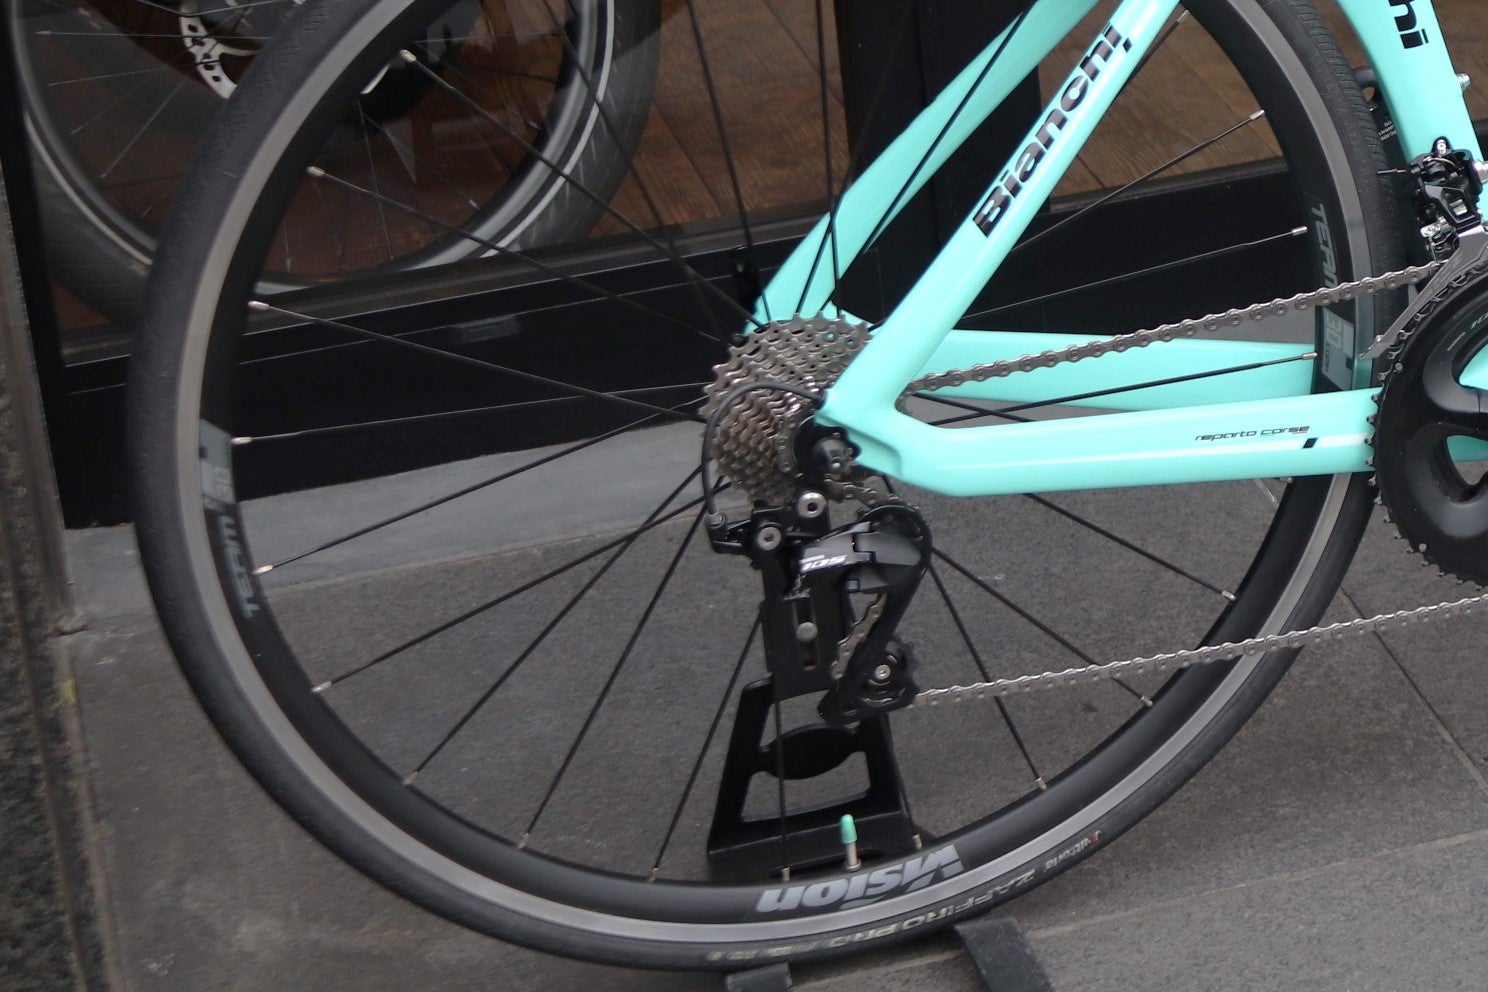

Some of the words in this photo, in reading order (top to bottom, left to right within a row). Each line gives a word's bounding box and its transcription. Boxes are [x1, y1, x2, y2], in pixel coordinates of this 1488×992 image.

[972, 21, 1122, 238] Bianchi
[1326, 314, 1342, 349] 30
[1195, 430, 1257, 442] reparto
[1260, 425, 1310, 437] corse
[755, 844, 965, 913] Vision
[902, 868, 1036, 931] ZAFFIRO
[828, 922, 898, 949] PRO
